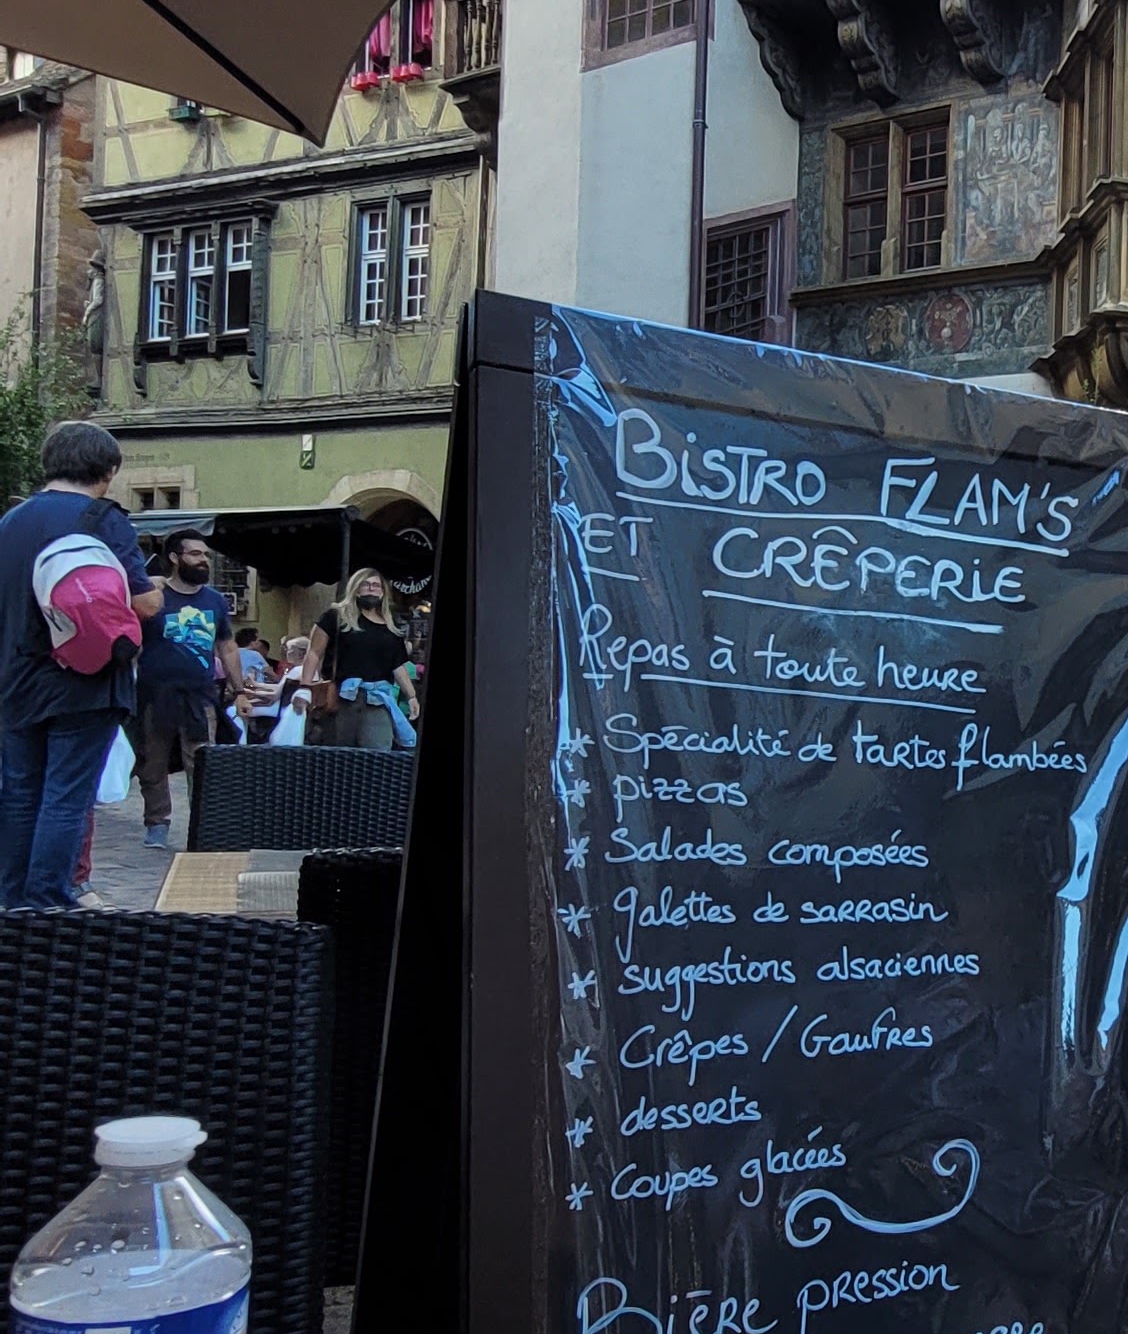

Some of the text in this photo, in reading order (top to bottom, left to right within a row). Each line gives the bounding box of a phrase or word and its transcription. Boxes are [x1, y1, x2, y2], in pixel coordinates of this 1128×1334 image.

[579, 512, 654, 557] ET
[879, 455, 1080, 543] FLAM'S
[579, 603, 987, 694] Repas à toute heure
[602, 714, 1088, 791] Spécialité de tartes flambées
[612, 775, 750, 822] pizzas
[604, 827, 930, 883] Salades composées
[613, 885, 949, 963] galettes de sarrasin
[618, 945, 981, 1021] suggestions alsaciennes
[618, 1026, 750, 1086] Crêpes
[800, 1007, 935, 1059] Gaufres
[620, 1087, 763, 1137] desserts
[609, 1125, 847, 1211] Coupes glacées
